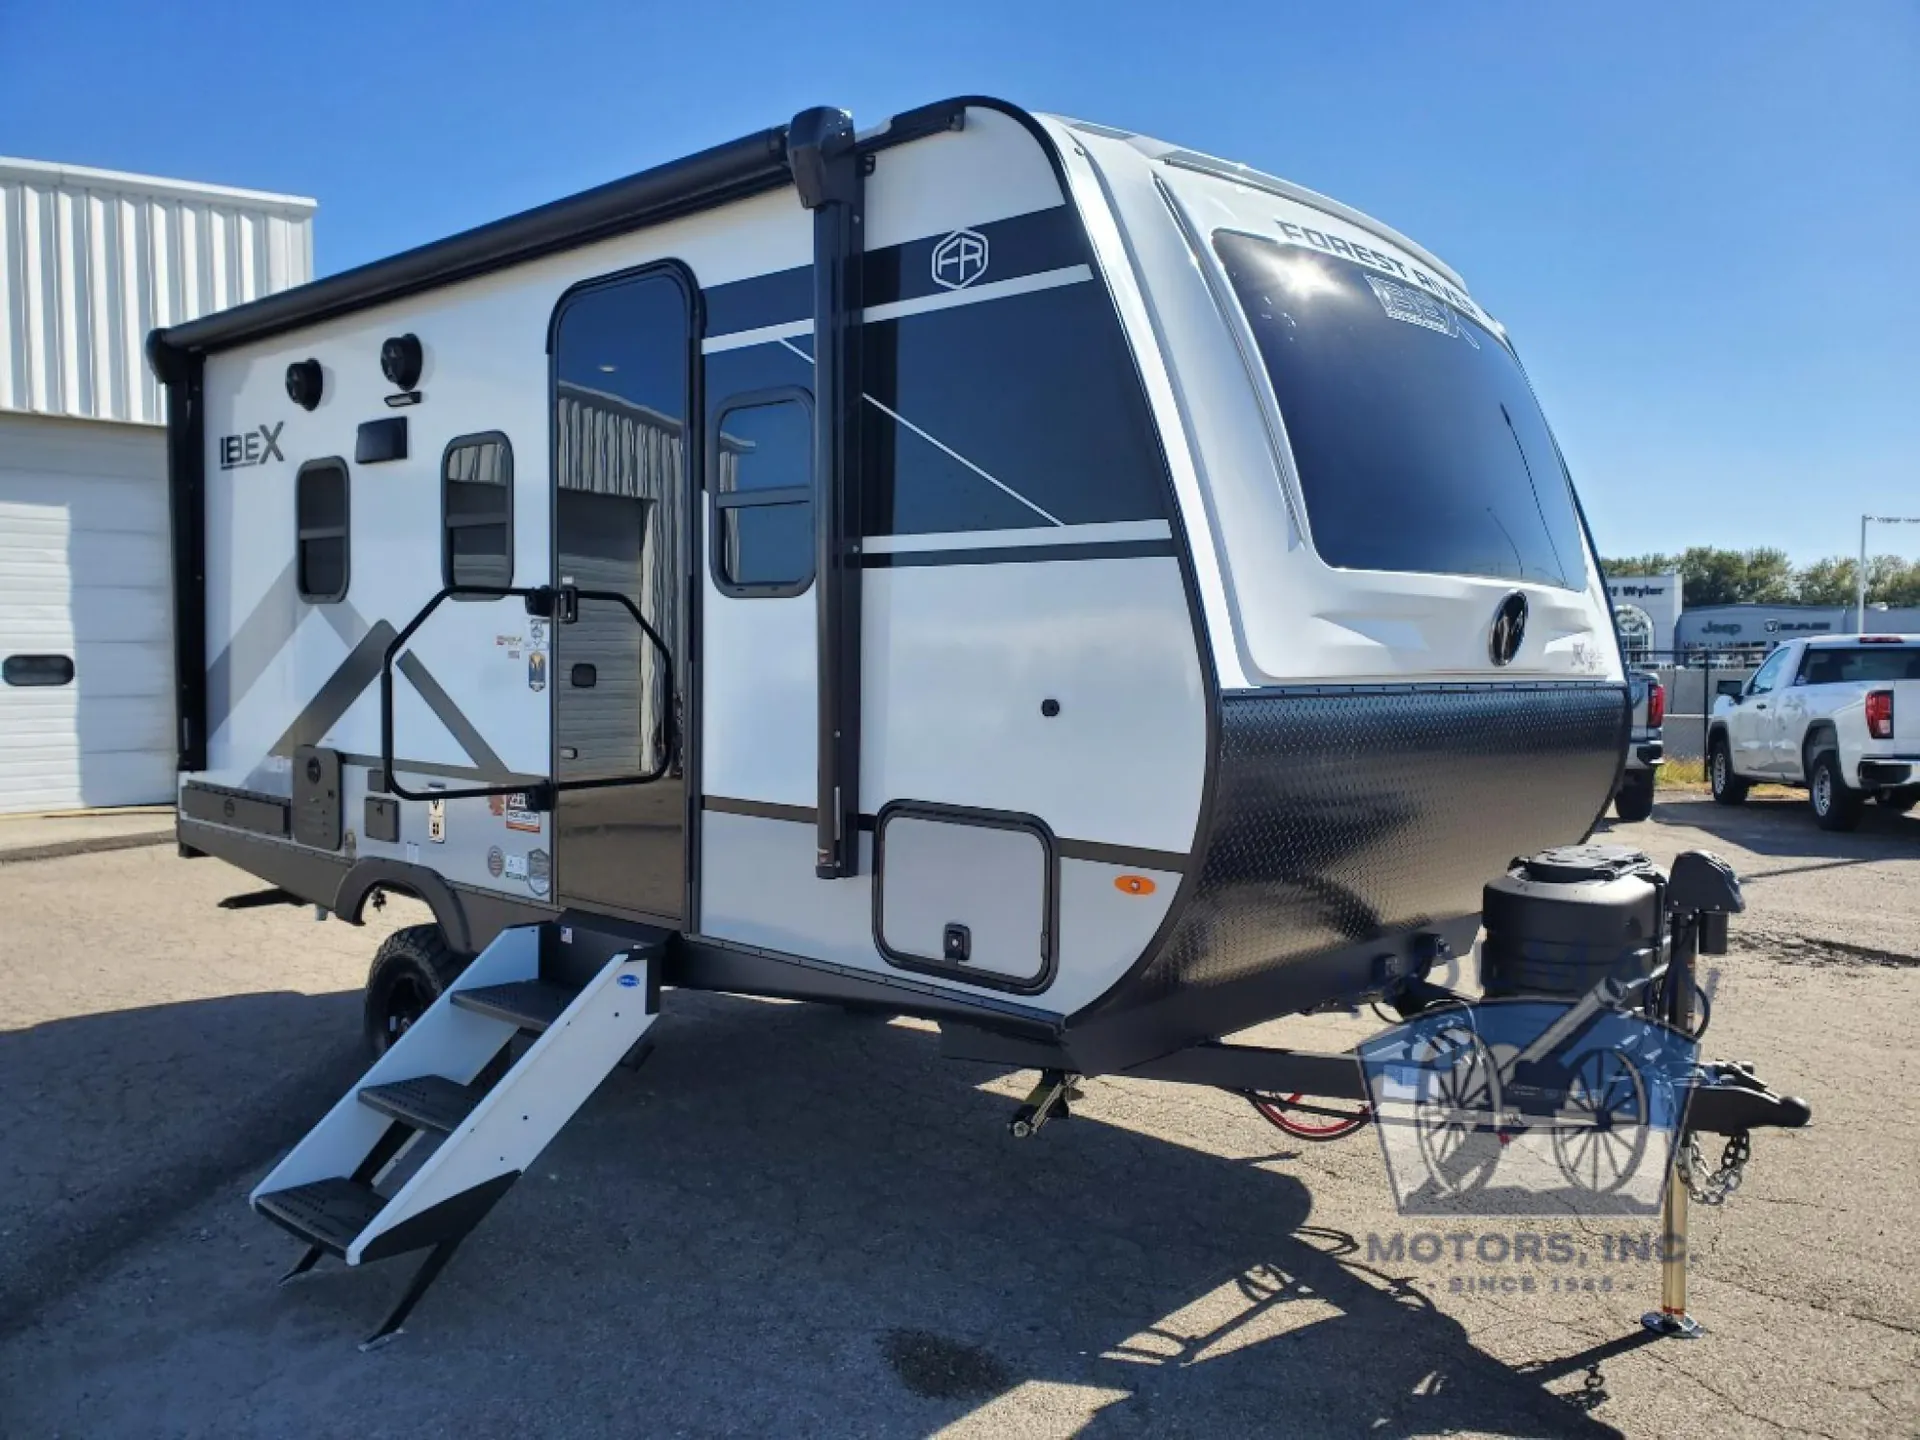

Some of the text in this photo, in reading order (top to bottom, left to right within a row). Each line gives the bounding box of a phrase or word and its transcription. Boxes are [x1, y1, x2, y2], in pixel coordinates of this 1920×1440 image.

[1274, 218, 1408, 278] FOREST
[1623, 585, 1664, 599] Wyler
[1702, 620, 1742, 636] Jeep
